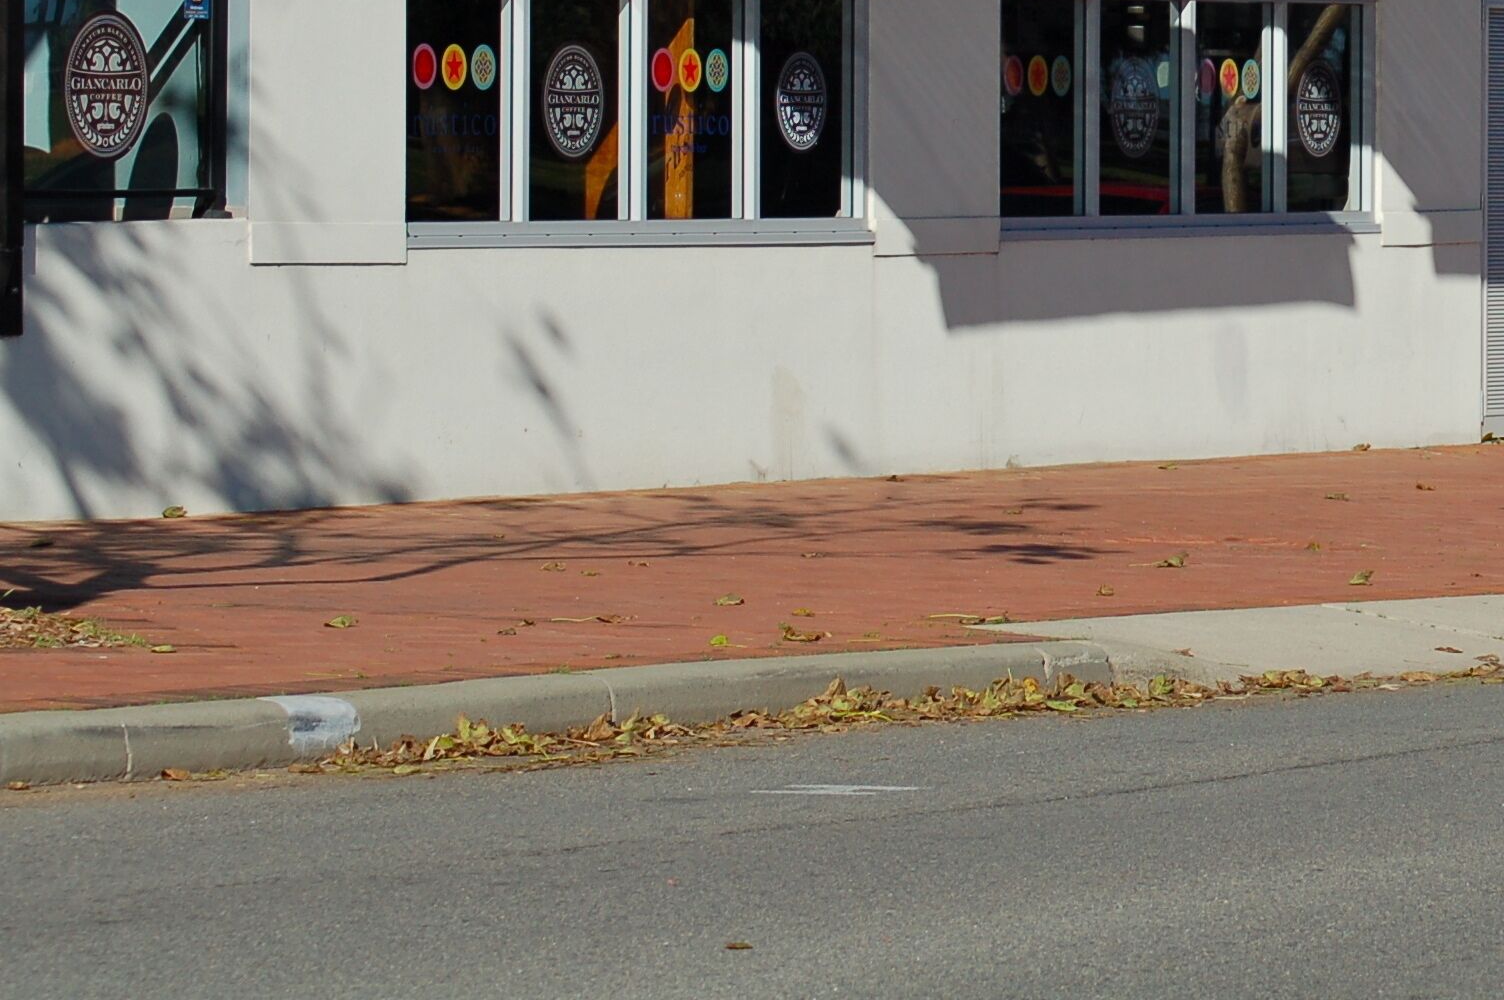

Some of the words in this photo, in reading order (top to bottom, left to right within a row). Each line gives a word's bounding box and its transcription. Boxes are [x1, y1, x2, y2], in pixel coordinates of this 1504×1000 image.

[71, 77, 142, 90] GIANCARLO
[89, 93, 123, 102] COFFEE
[548, 94, 600, 105] GIANCARLO
